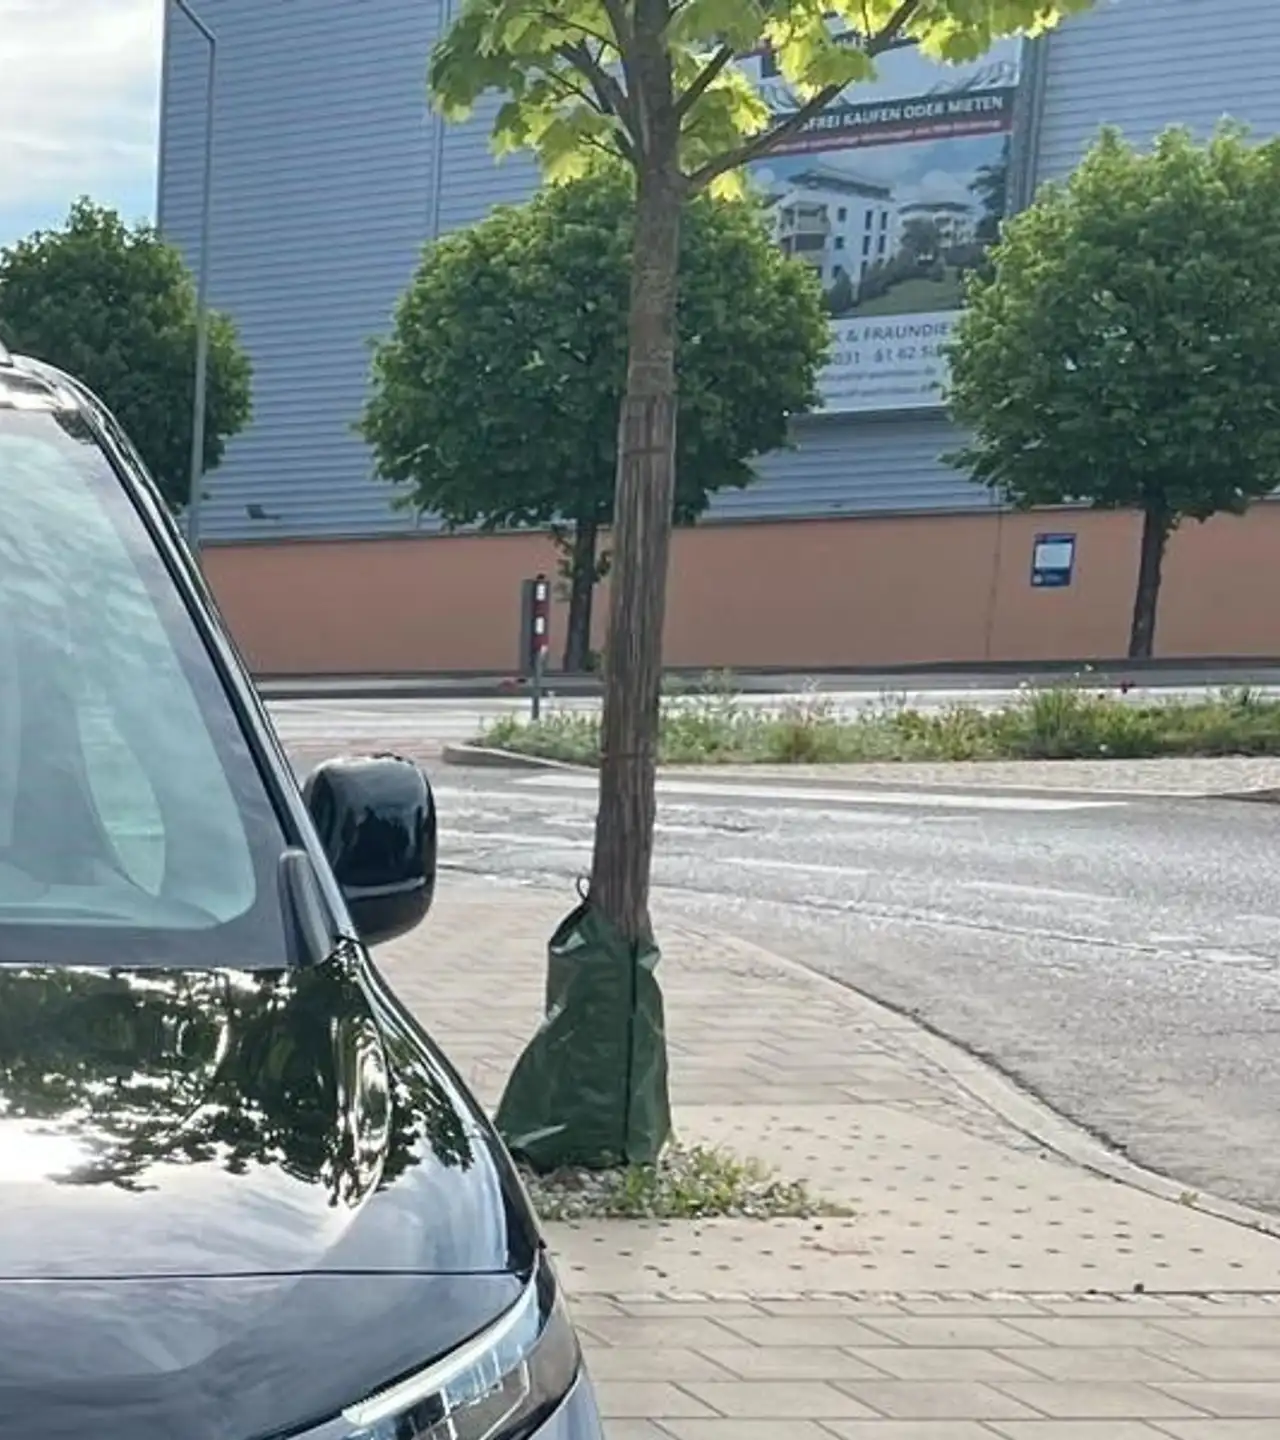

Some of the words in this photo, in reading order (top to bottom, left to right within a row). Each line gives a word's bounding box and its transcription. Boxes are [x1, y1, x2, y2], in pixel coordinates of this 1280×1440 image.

[843, 106, 900, 126] KAUFEN
[903, 101, 943, 120] ODER
[947, 96, 1003, 115] MIETEN
[864, 321, 951, 341] FRAUNDIE
